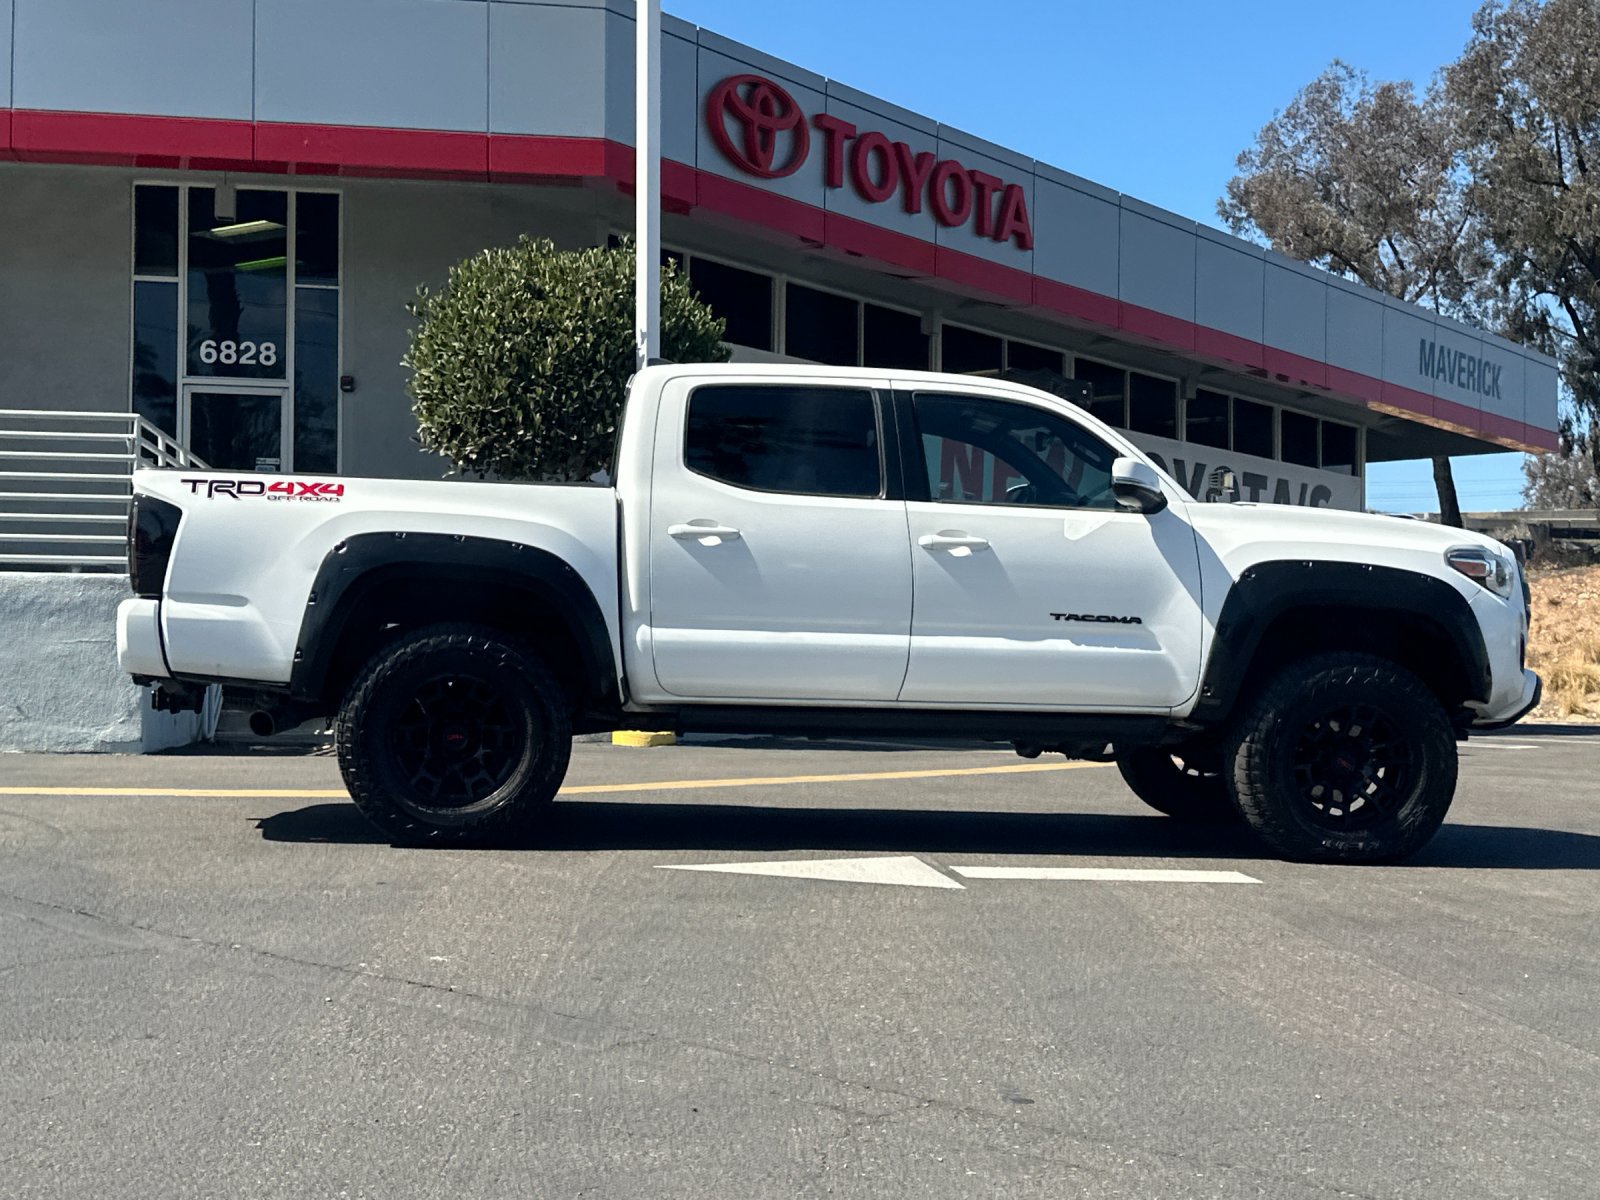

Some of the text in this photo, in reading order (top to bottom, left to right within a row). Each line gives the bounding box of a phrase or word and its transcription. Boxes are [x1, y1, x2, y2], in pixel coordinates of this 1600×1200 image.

[811, 113, 1034, 250] TOYOTA
[200, 340, 277, 366] 6828
[1419, 338, 1502, 400] MAVERICK
[181, 479, 267, 499] TRD
[267, 495, 296, 503] OFF
[1049, 612, 1142, 624] TACOMA
